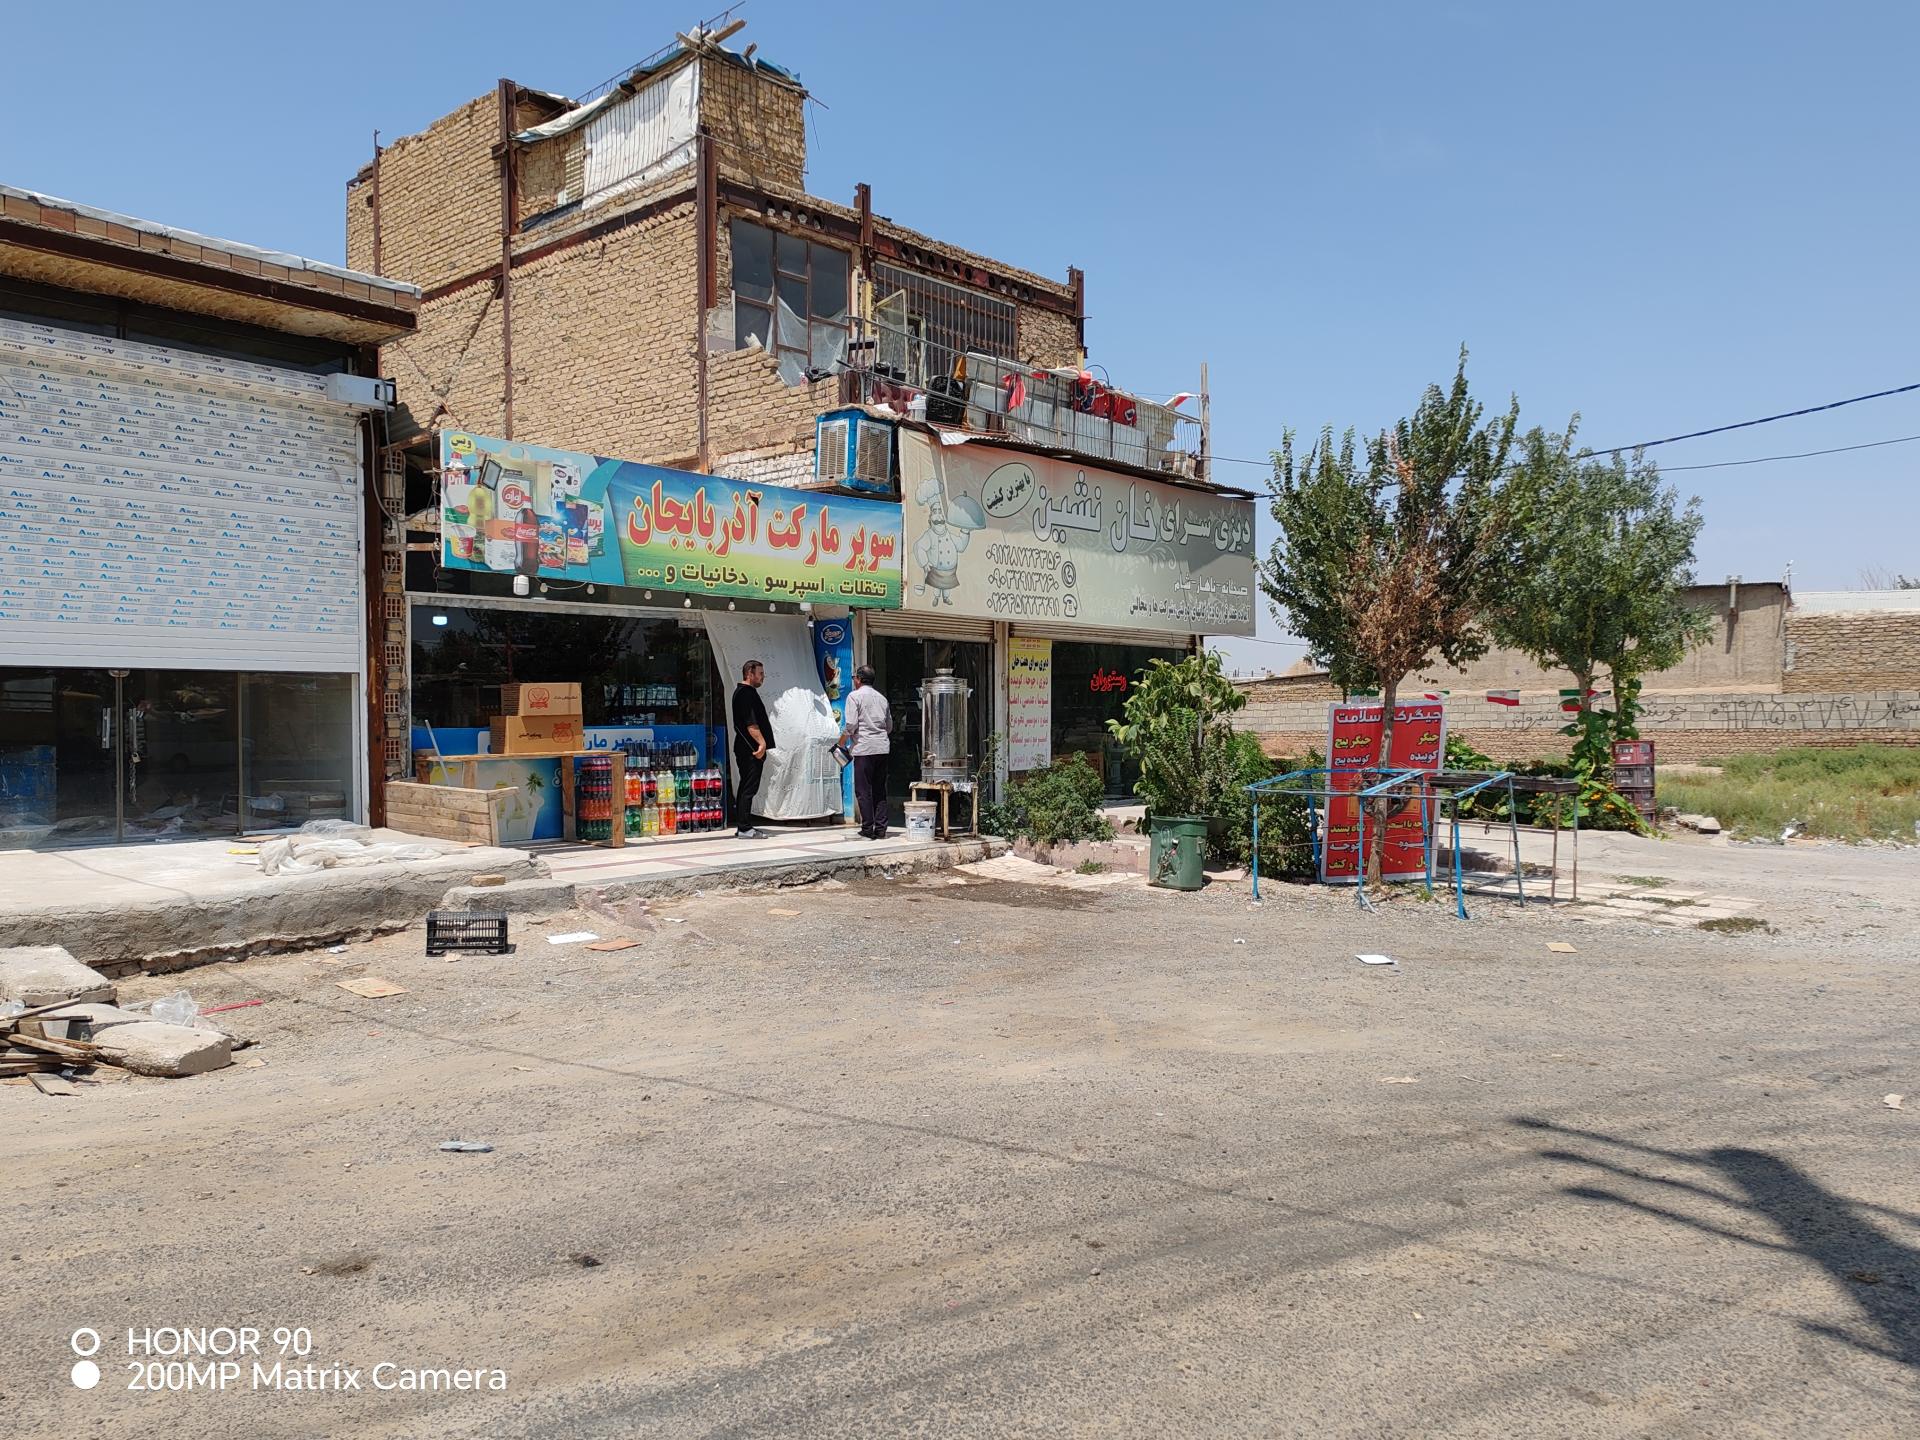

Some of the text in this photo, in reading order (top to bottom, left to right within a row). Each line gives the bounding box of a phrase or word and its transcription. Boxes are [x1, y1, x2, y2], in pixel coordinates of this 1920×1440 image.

[627, 480, 763, 557] آذربایجان
[1033, 470, 1101, 544] نشین
[1110, 480, 1157, 552] خان
[843, 523, 896, 573] سوپر
[1091, 667, 1126, 691] رستوران
[1336, 708, 1442, 724] جیگرک سلامت
